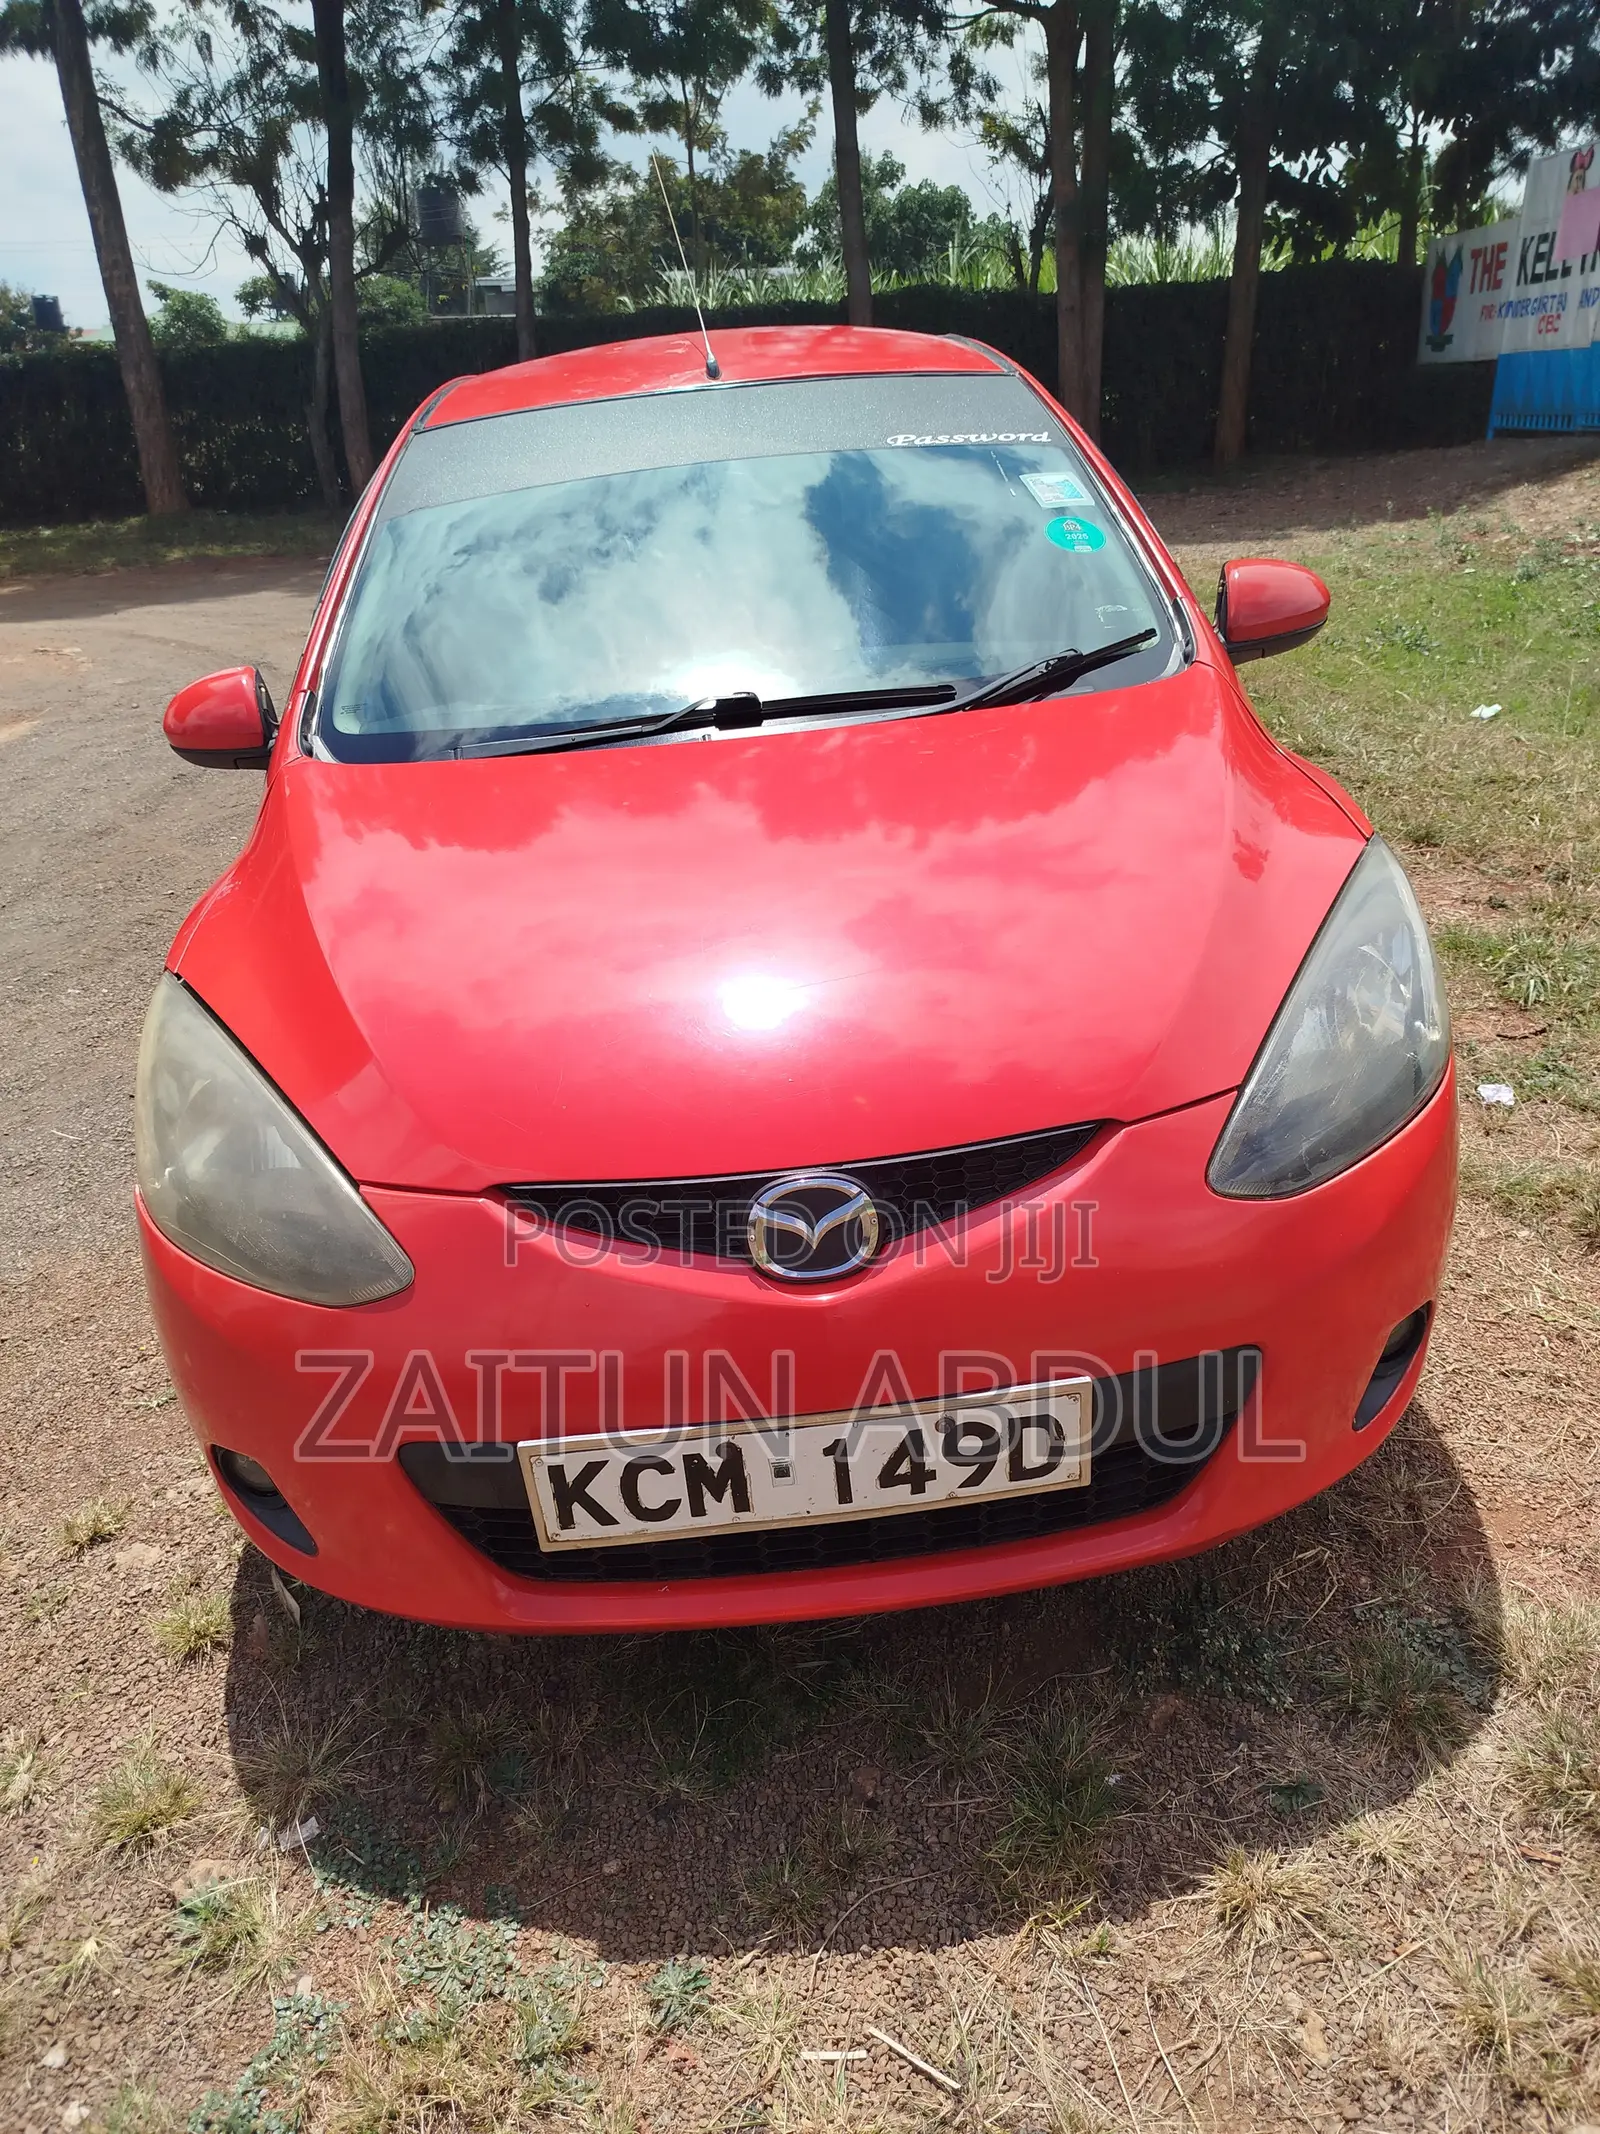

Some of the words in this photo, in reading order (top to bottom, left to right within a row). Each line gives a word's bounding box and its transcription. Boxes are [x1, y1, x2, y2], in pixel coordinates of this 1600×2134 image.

[1470, 241, 1508, 294] THE
[886, 431, 1052, 446] Password
[547, 1438, 755, 1531] KCM
[821, 1414, 1067, 1506] 149D
